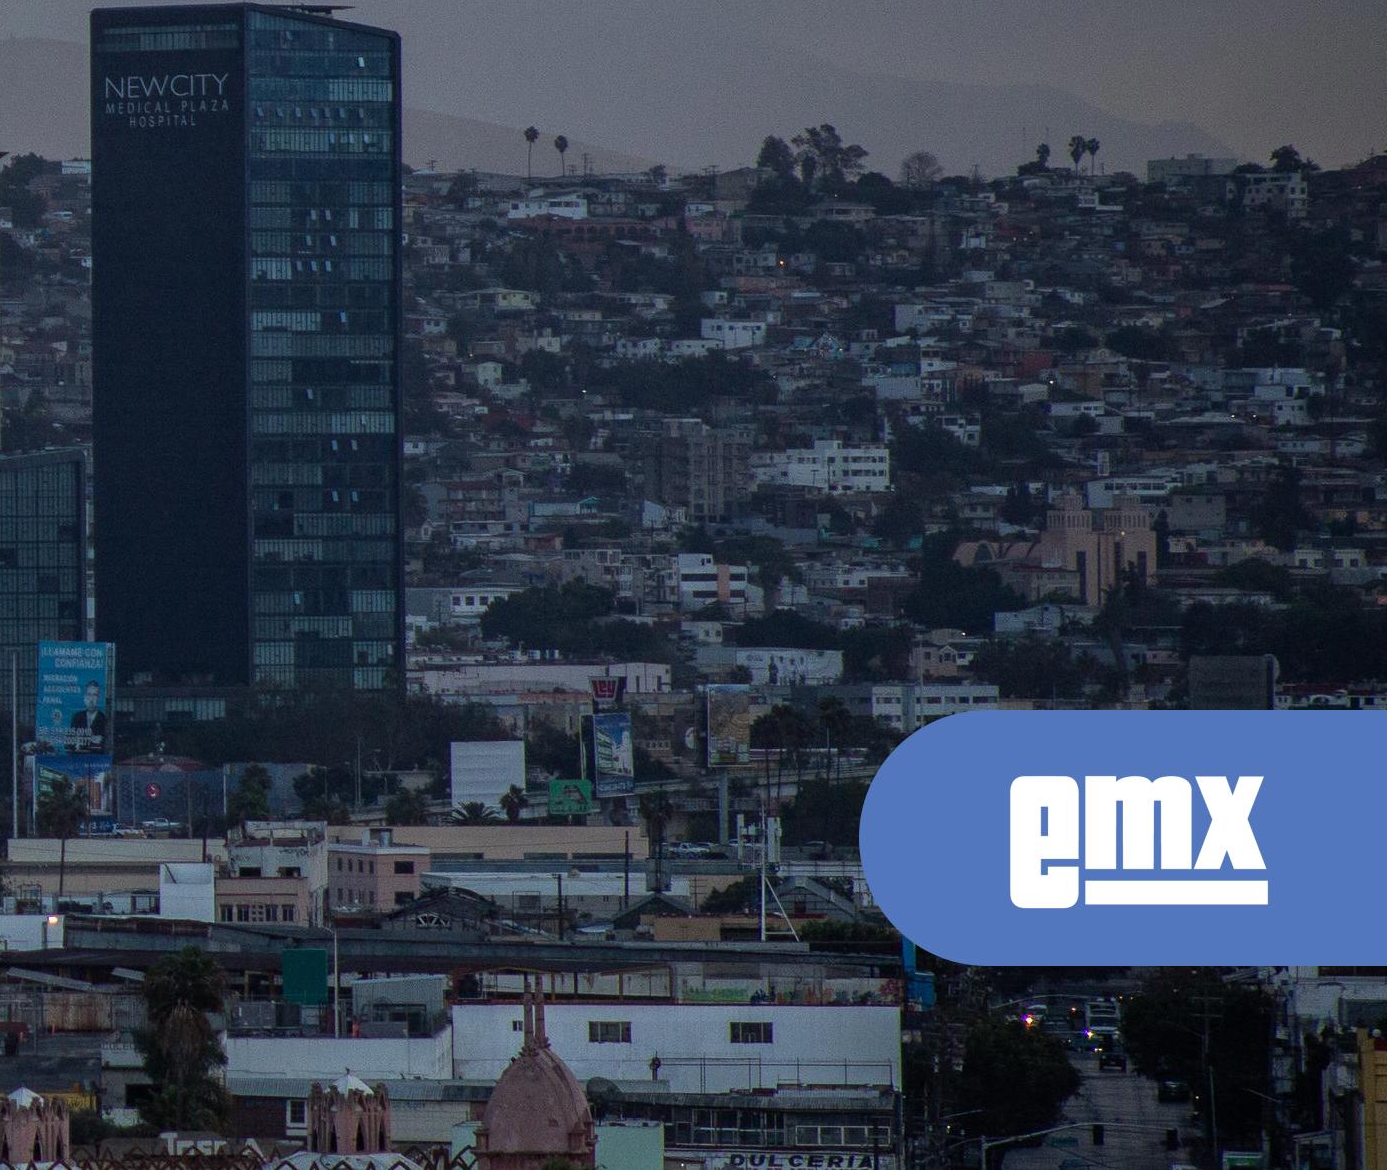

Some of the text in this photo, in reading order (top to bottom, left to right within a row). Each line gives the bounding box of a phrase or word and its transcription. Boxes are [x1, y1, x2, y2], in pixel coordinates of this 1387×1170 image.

[106, 99, 229, 115] MEDICAL PLAZA
[129, 114, 196, 128] HOSPITAL
